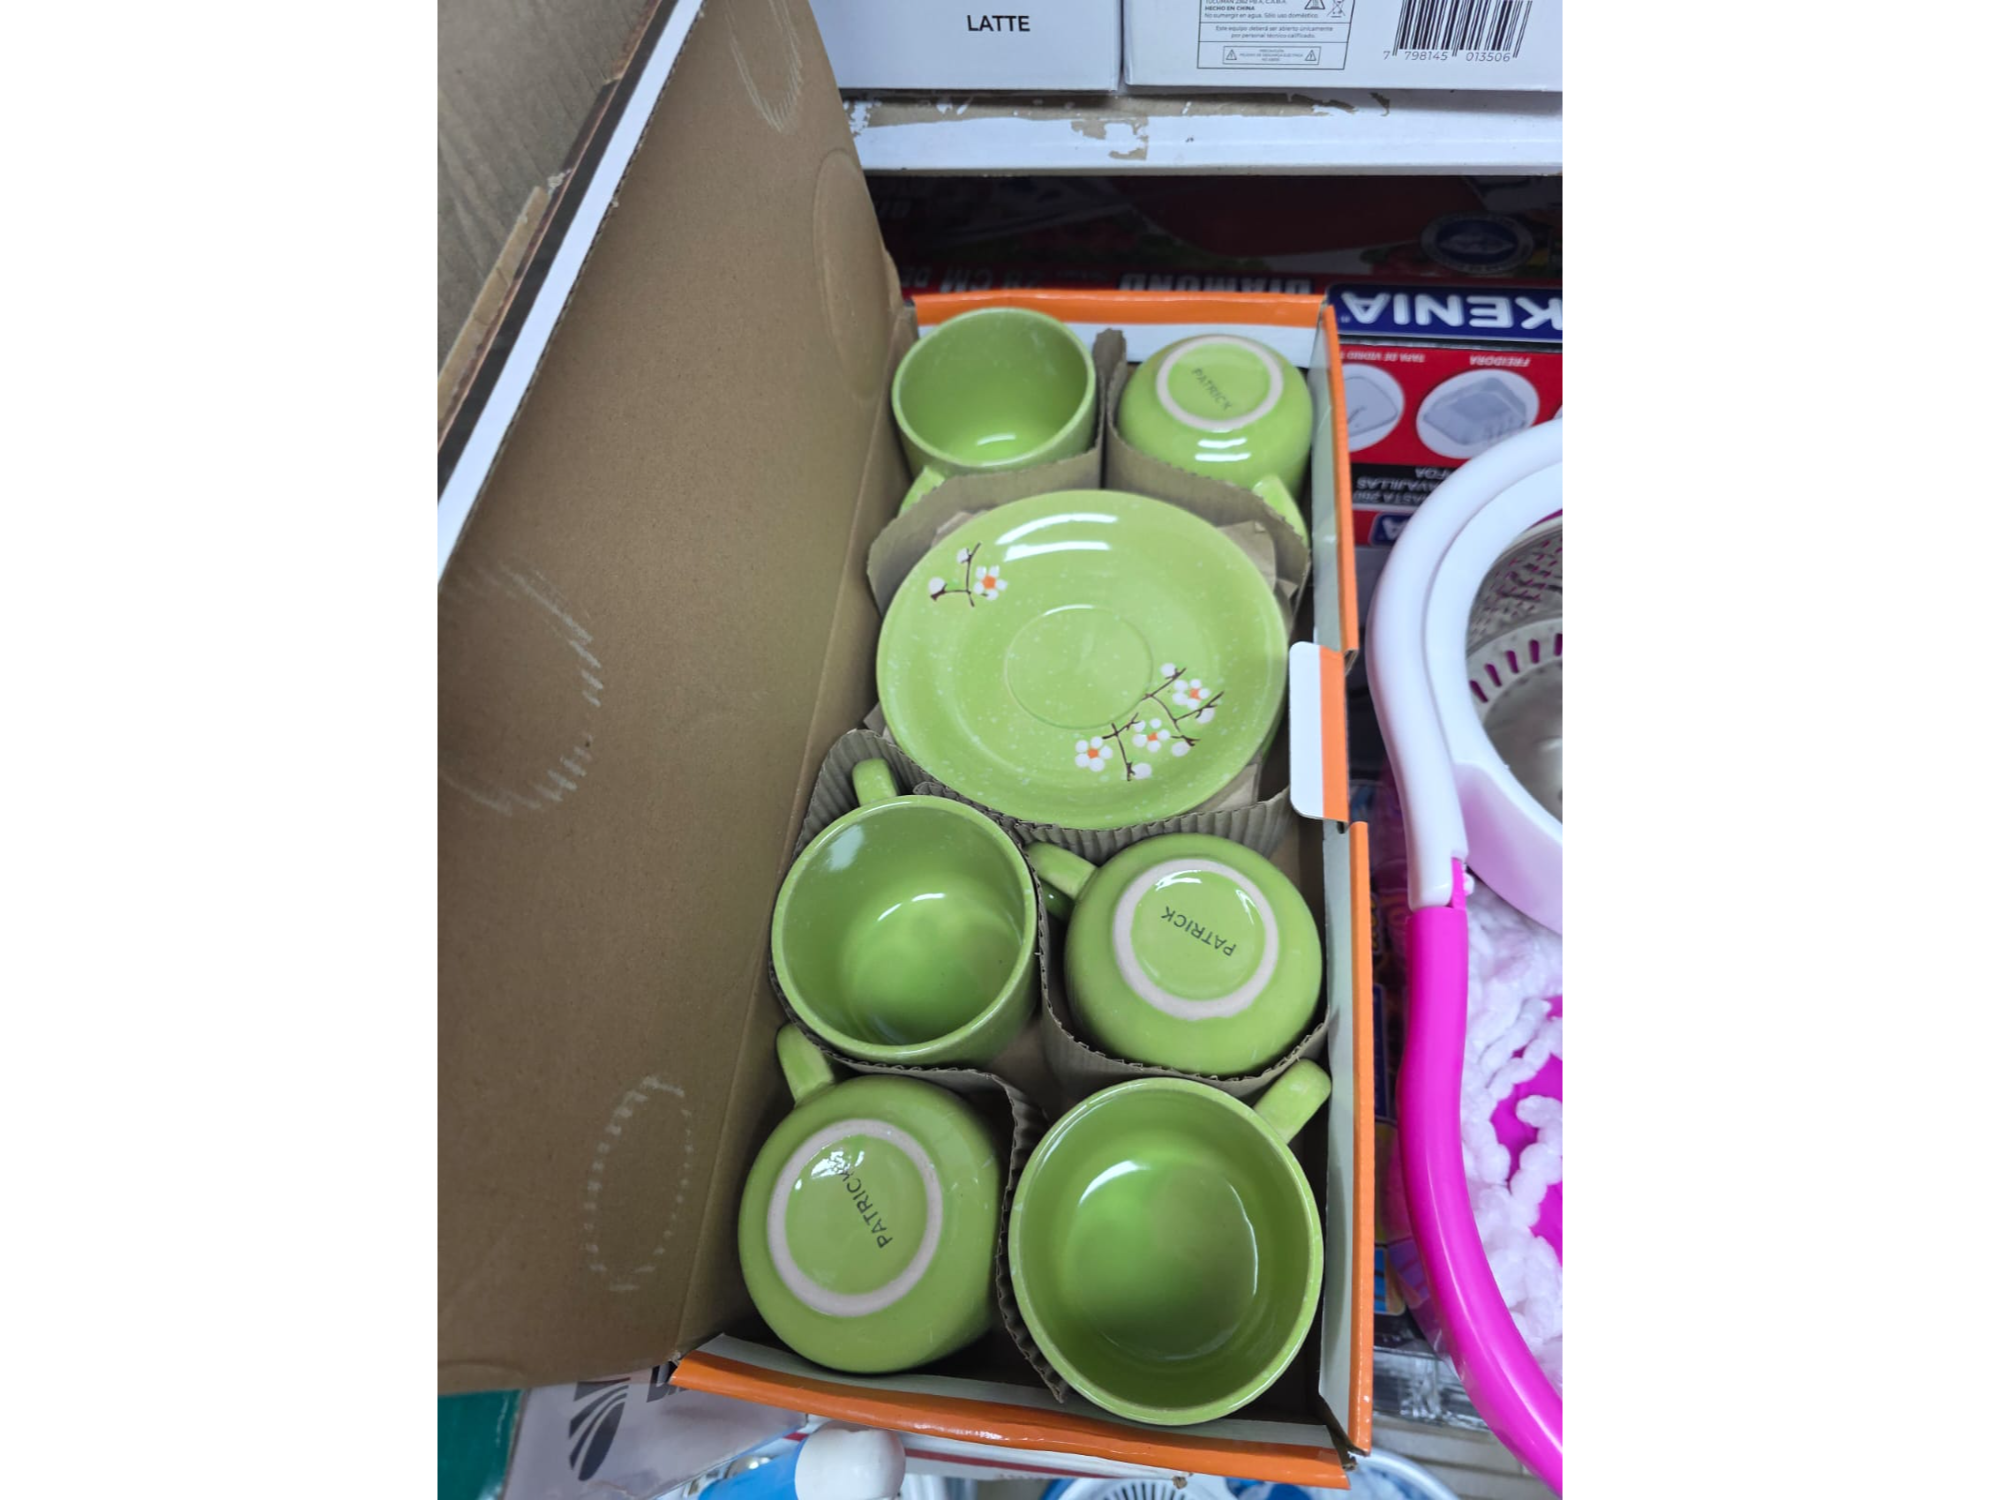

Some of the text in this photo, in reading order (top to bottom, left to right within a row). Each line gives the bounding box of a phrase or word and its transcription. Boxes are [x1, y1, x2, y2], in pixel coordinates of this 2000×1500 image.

[967, 15, 1031, 32] LATTE
[1383, 51, 1511, 62] 7 798145 013506
[1340, 292, 1562, 331] KENIA
[1469, 355, 1531, 367] FREIDORA
[1191, 367, 1233, 411] PATRICK
[1356, 475, 1440, 492] AVAJILLAS
[1160, 905, 1237, 957] PATRICK
[839, 1168, 894, 1249] PATRICK
